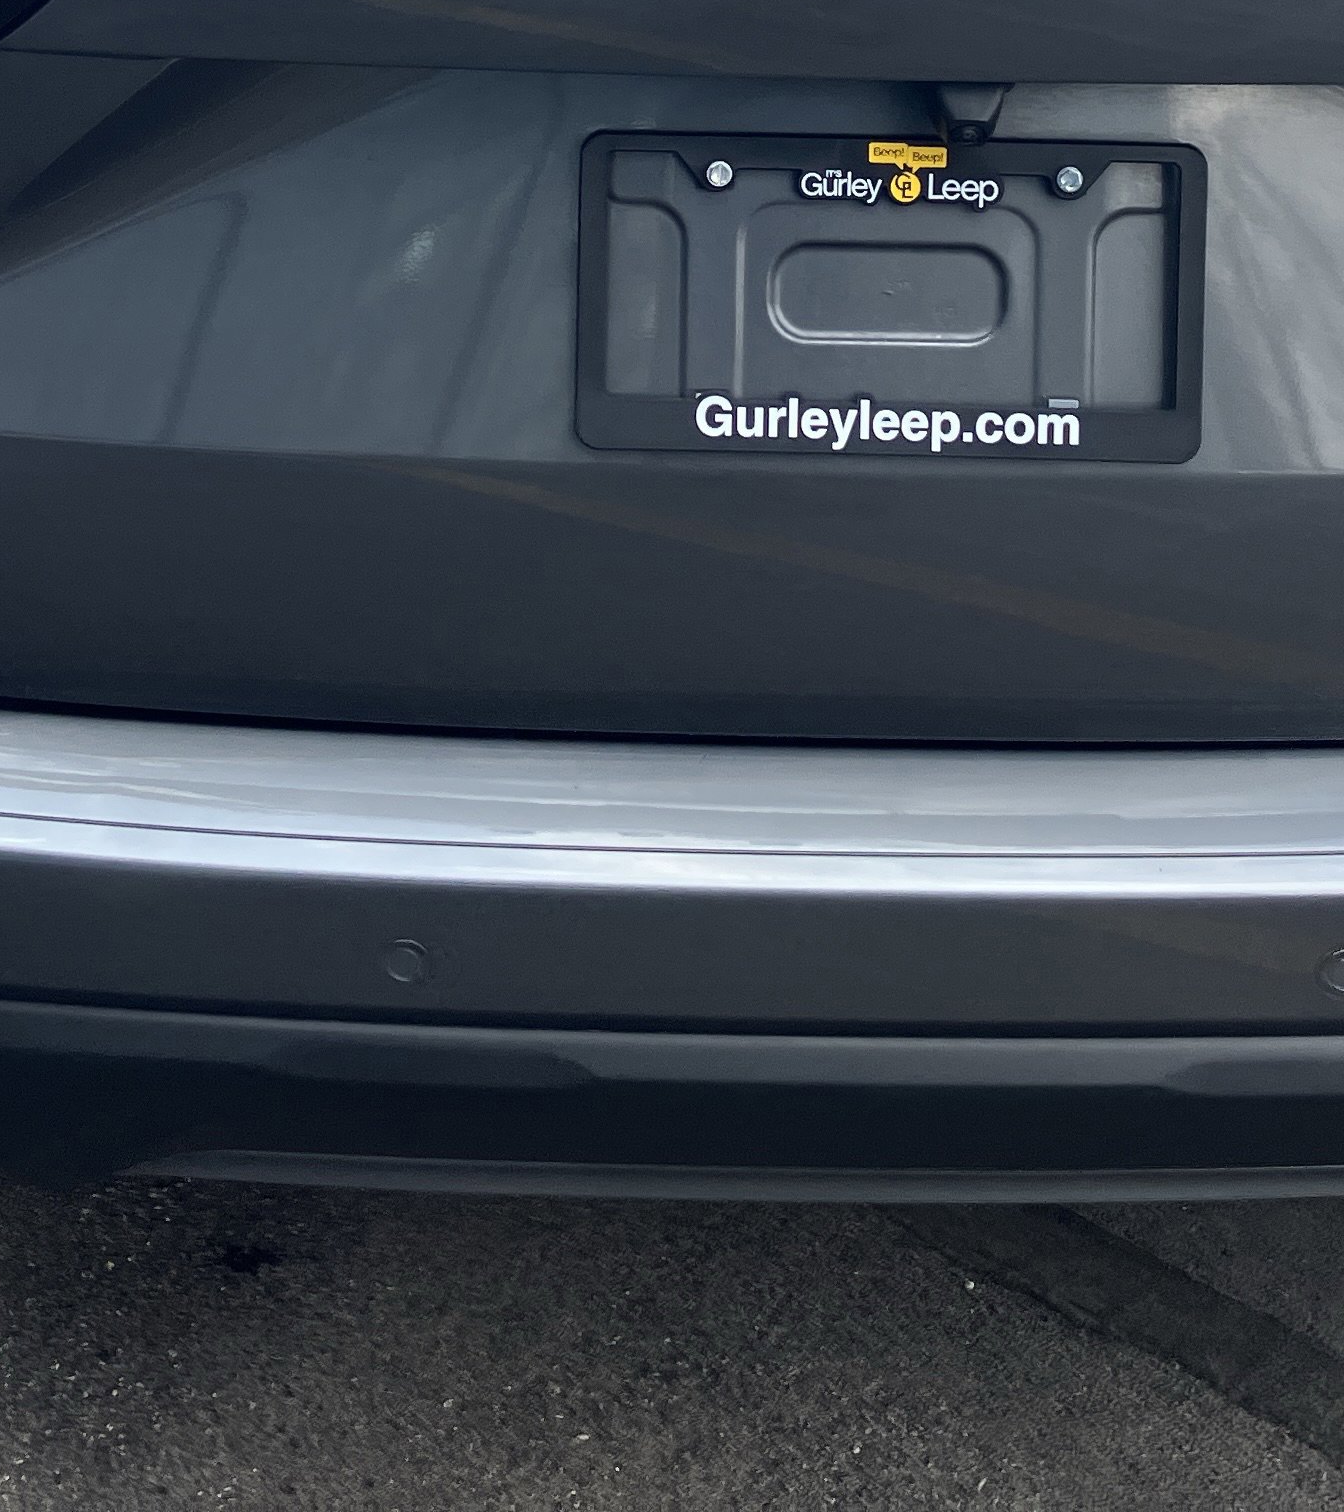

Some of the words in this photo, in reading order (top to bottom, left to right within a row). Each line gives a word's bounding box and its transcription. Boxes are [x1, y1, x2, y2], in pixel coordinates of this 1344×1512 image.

[800, 171, 883, 204] Gurley
[927, 173, 1000, 209] Leep
[695, 394, 1080, 453] Gurleyleep.com
